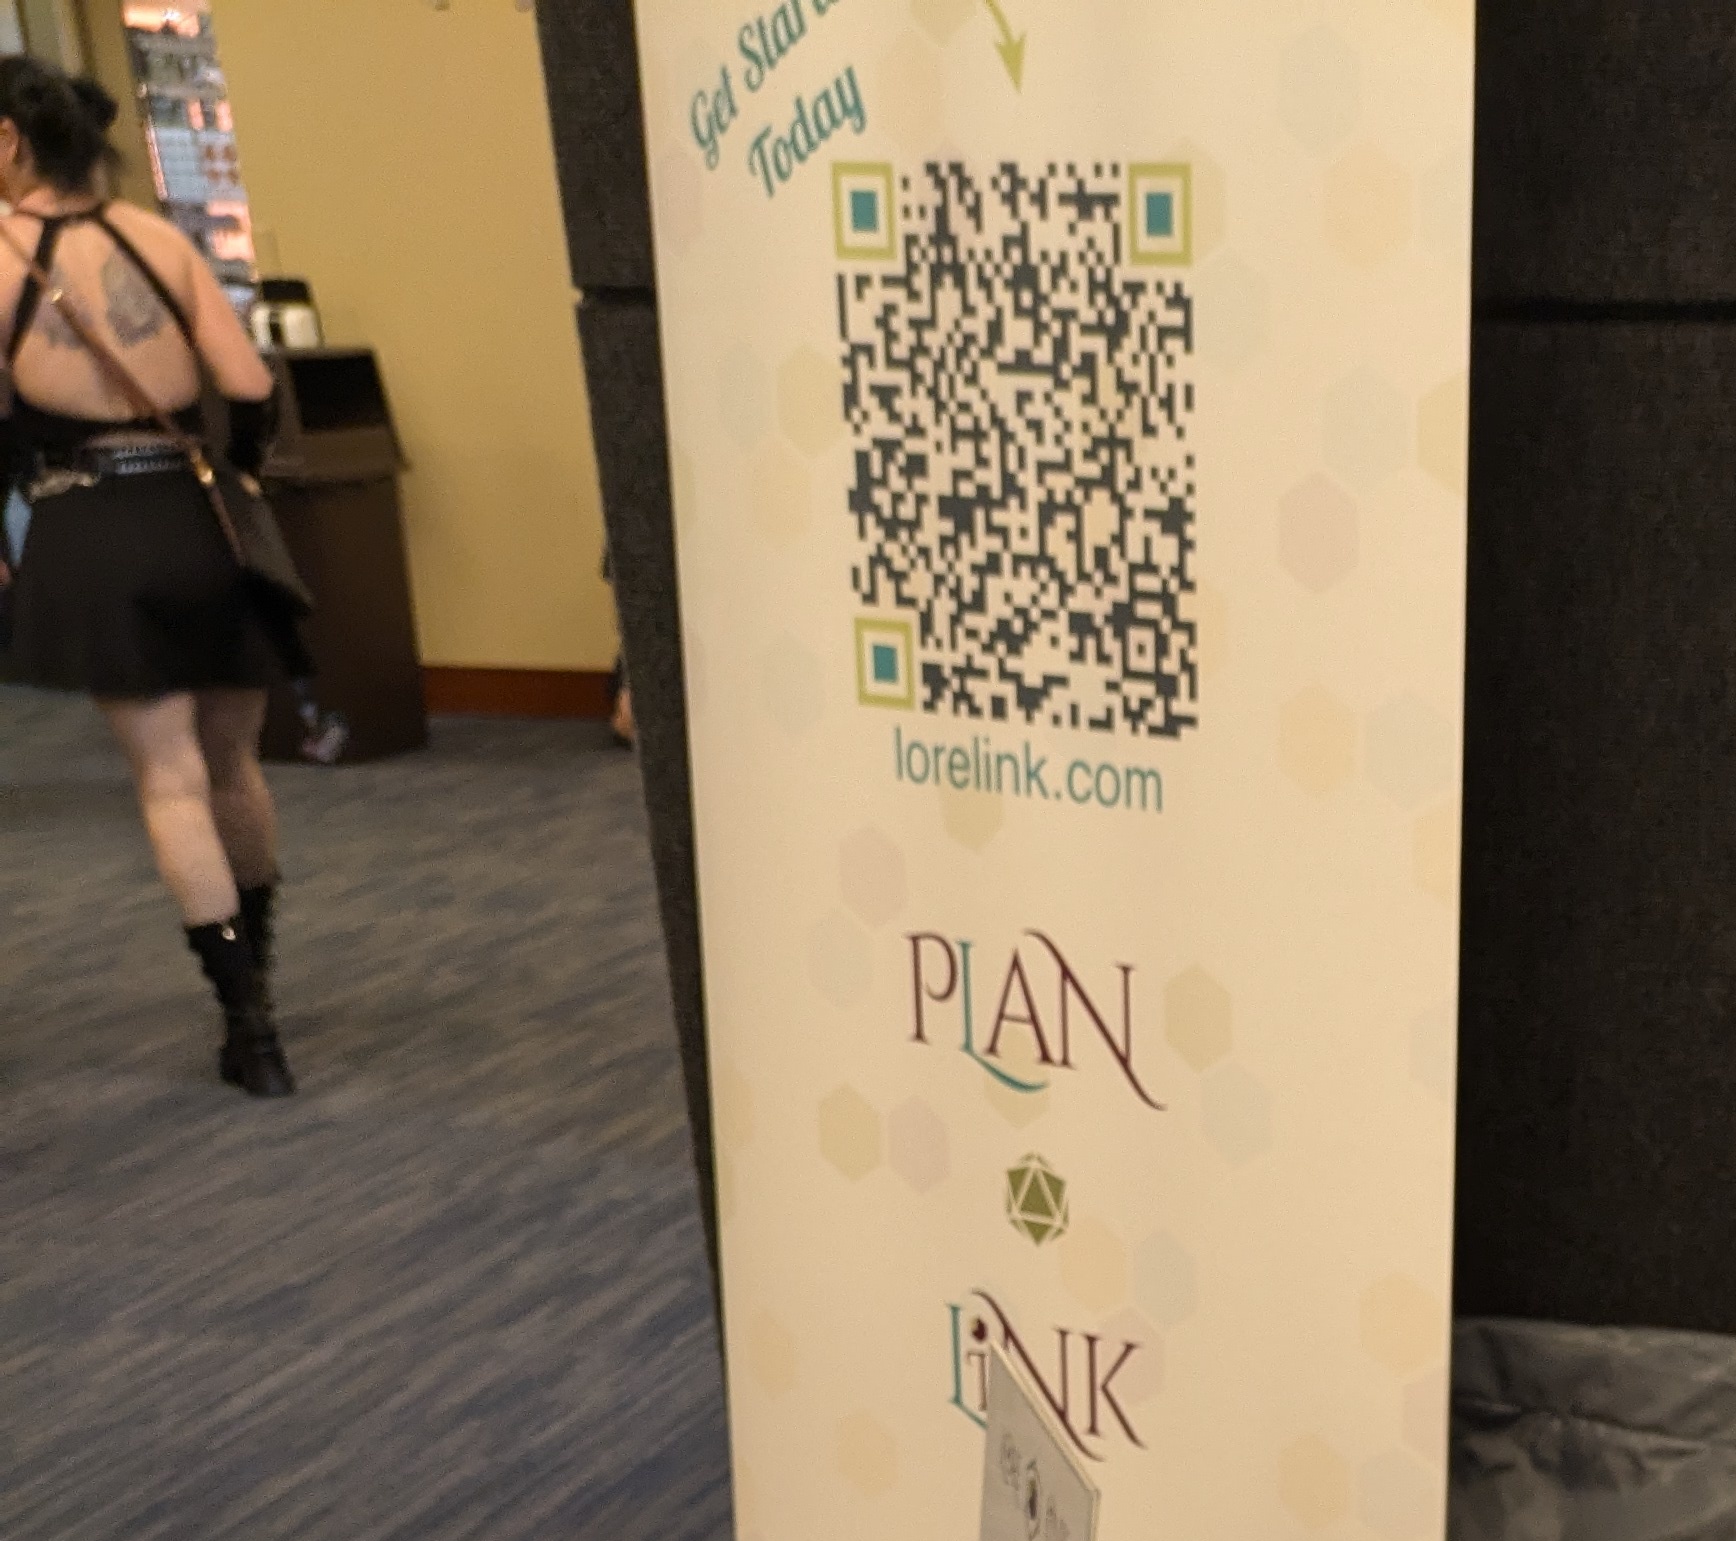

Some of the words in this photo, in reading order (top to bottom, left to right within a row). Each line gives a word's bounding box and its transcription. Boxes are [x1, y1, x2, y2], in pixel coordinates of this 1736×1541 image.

[690, 64, 738, 170] Get
[738, 0, 839, 92] Star
[747, 64, 867, 197] Today
[893, 725, 1165, 814] lorelink.com
[904, 928, 1168, 1112] PLAN
